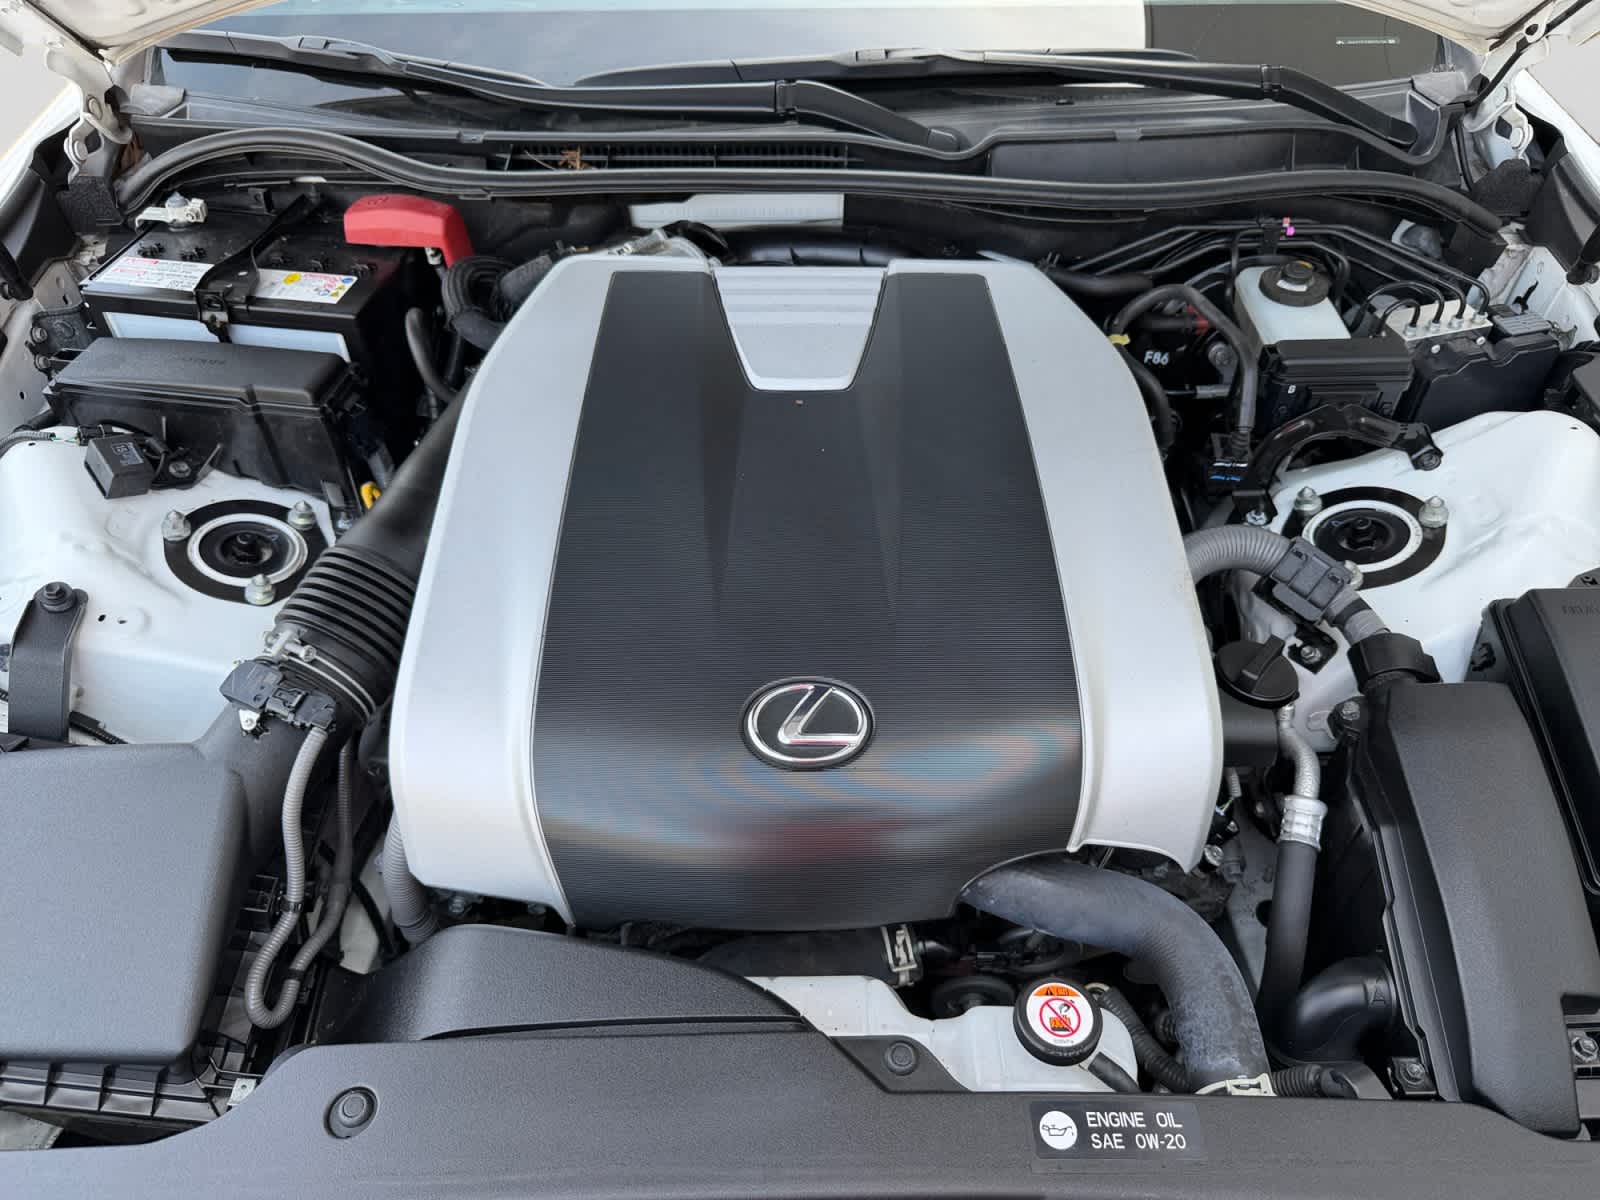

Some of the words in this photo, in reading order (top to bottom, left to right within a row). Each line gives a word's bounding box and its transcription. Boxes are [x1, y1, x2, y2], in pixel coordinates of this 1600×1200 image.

[1143, 351, 1169, 365] F86
[1085, 1111, 1147, 1128] ENGINE
[1155, 1112, 1183, 1128] OIL
[1090, 1133, 1126, 1149] SAE
[1135, 1133, 1187, 1150] 0W-20
